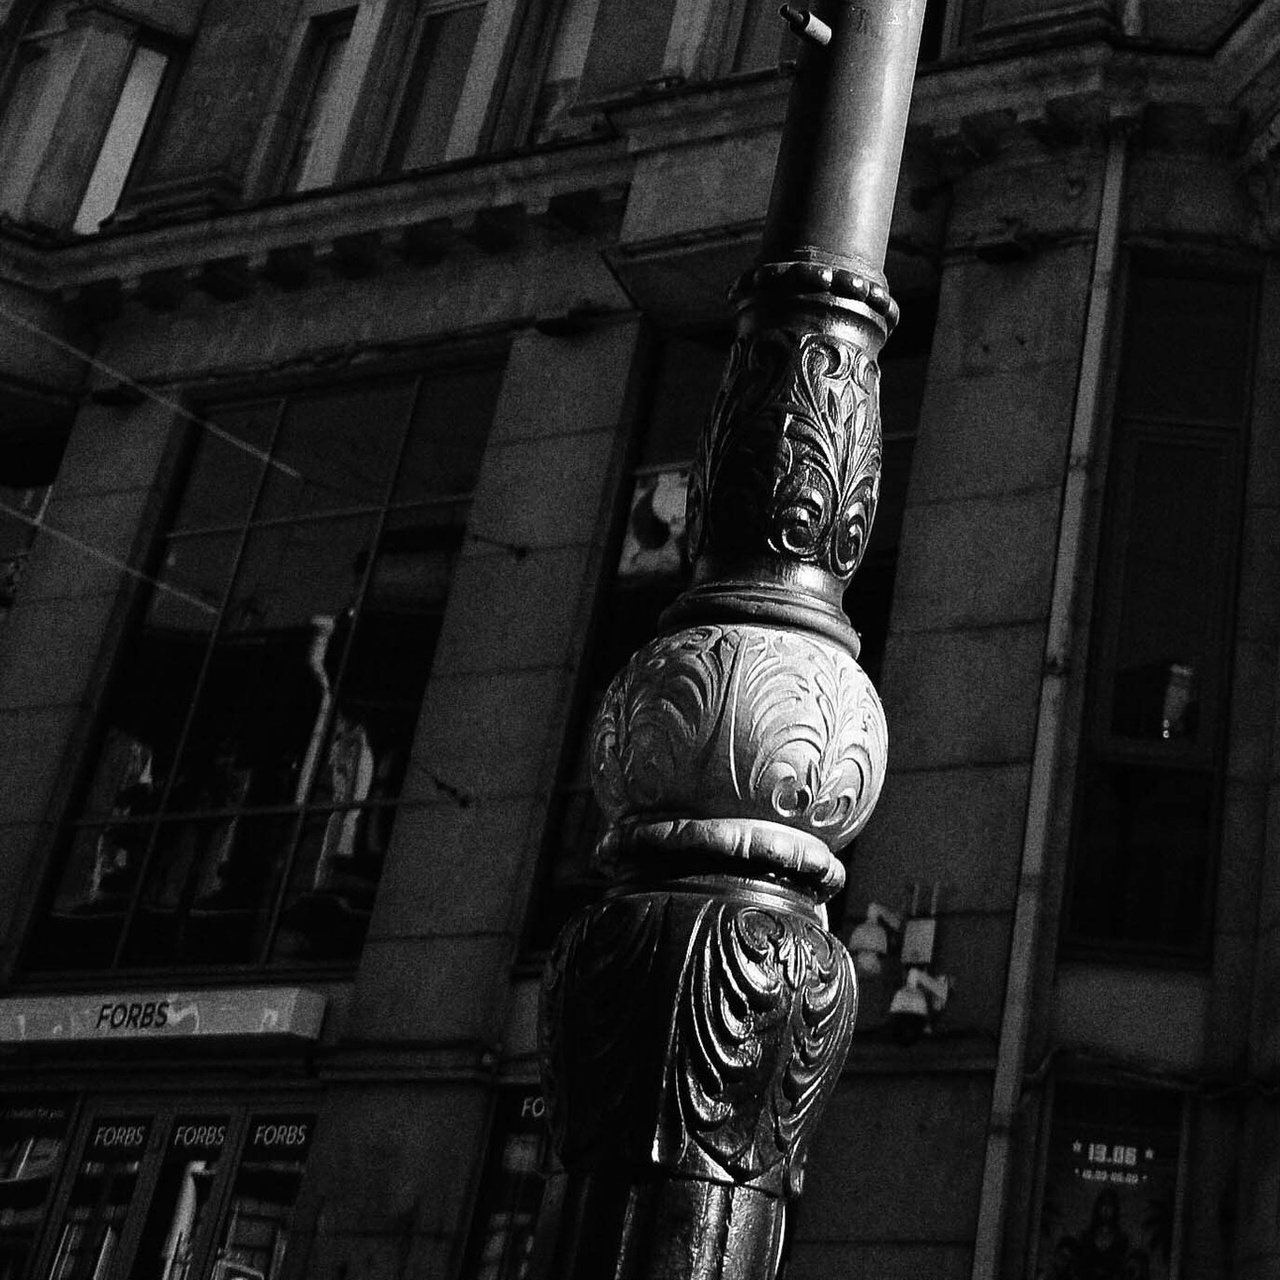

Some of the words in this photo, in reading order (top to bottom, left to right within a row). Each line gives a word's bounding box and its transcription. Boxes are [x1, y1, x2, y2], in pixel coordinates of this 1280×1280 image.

[95, 1001, 170, 1030] FORBS
[94, 1122, 146, 1146] FORBS
[174, 1124, 226, 1146] FORBS
[254, 1123, 307, 1146] FORBS
